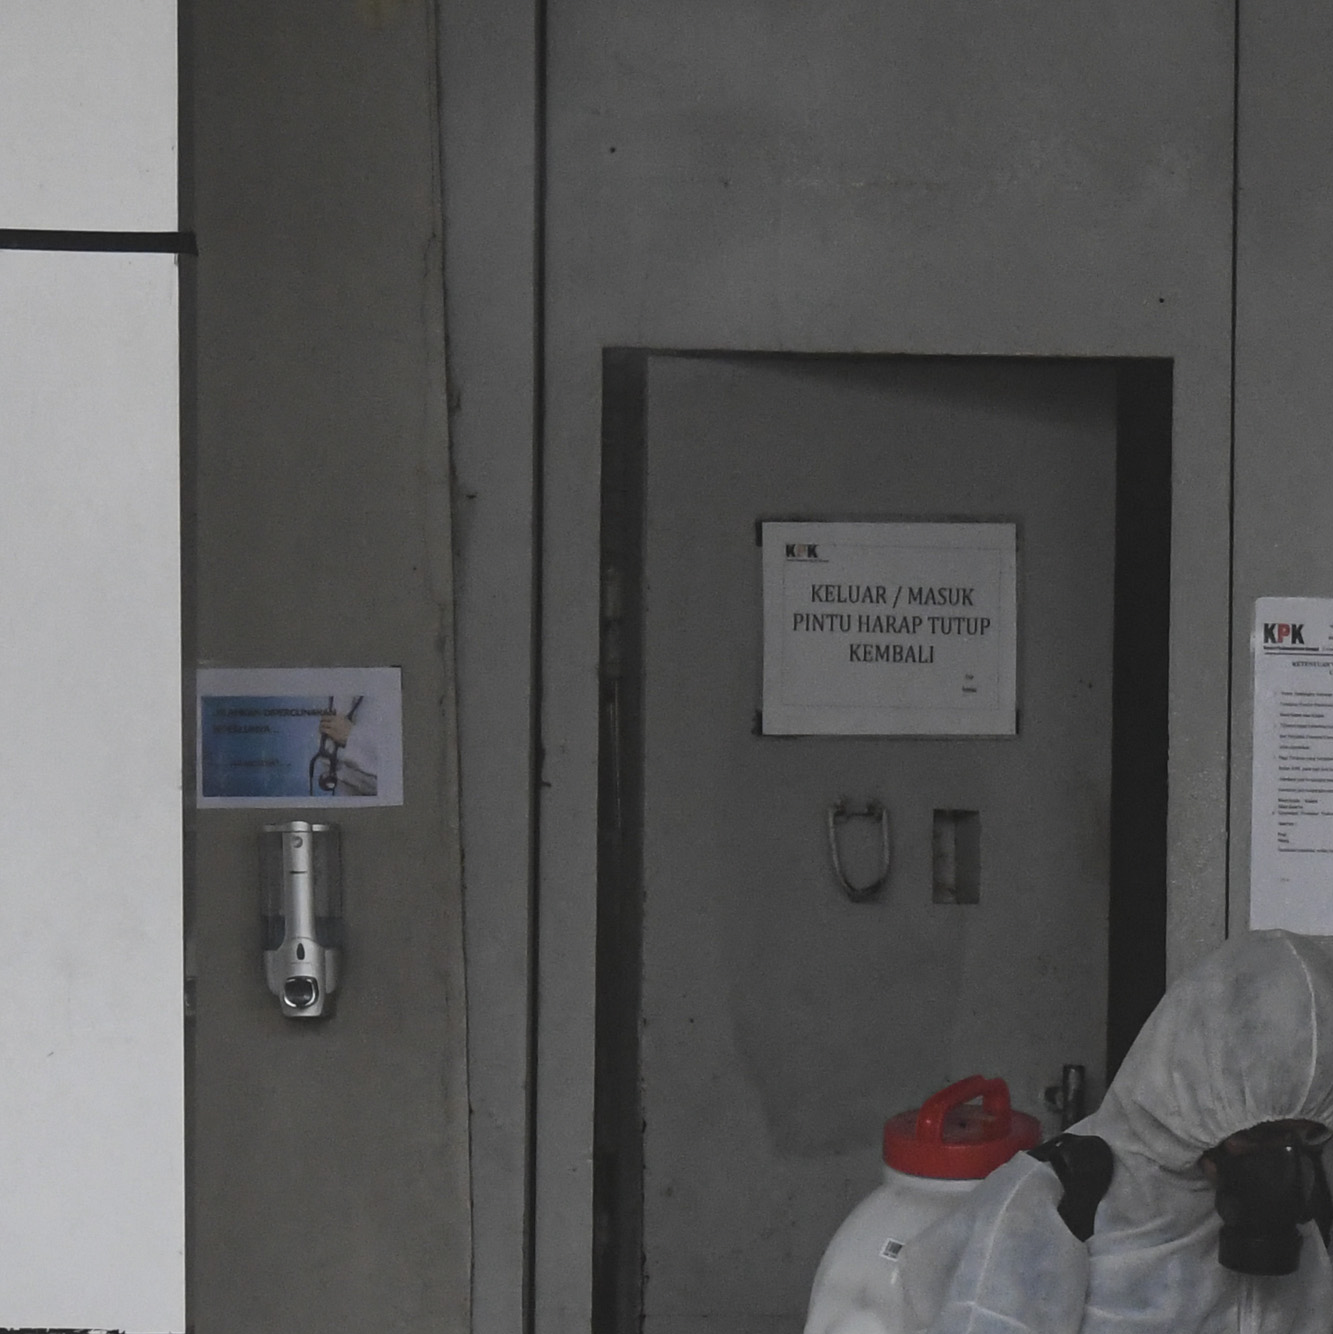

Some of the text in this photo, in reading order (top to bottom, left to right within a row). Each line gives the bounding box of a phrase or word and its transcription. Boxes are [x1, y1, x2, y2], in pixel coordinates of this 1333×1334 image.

[811, 584, 975, 609] KELUAR / MASUK
[793, 613, 991, 636] PINTU HARAP TUTUP
[1264, 623, 1304, 644] KPK
[849, 644, 934, 664] KEMBALI
